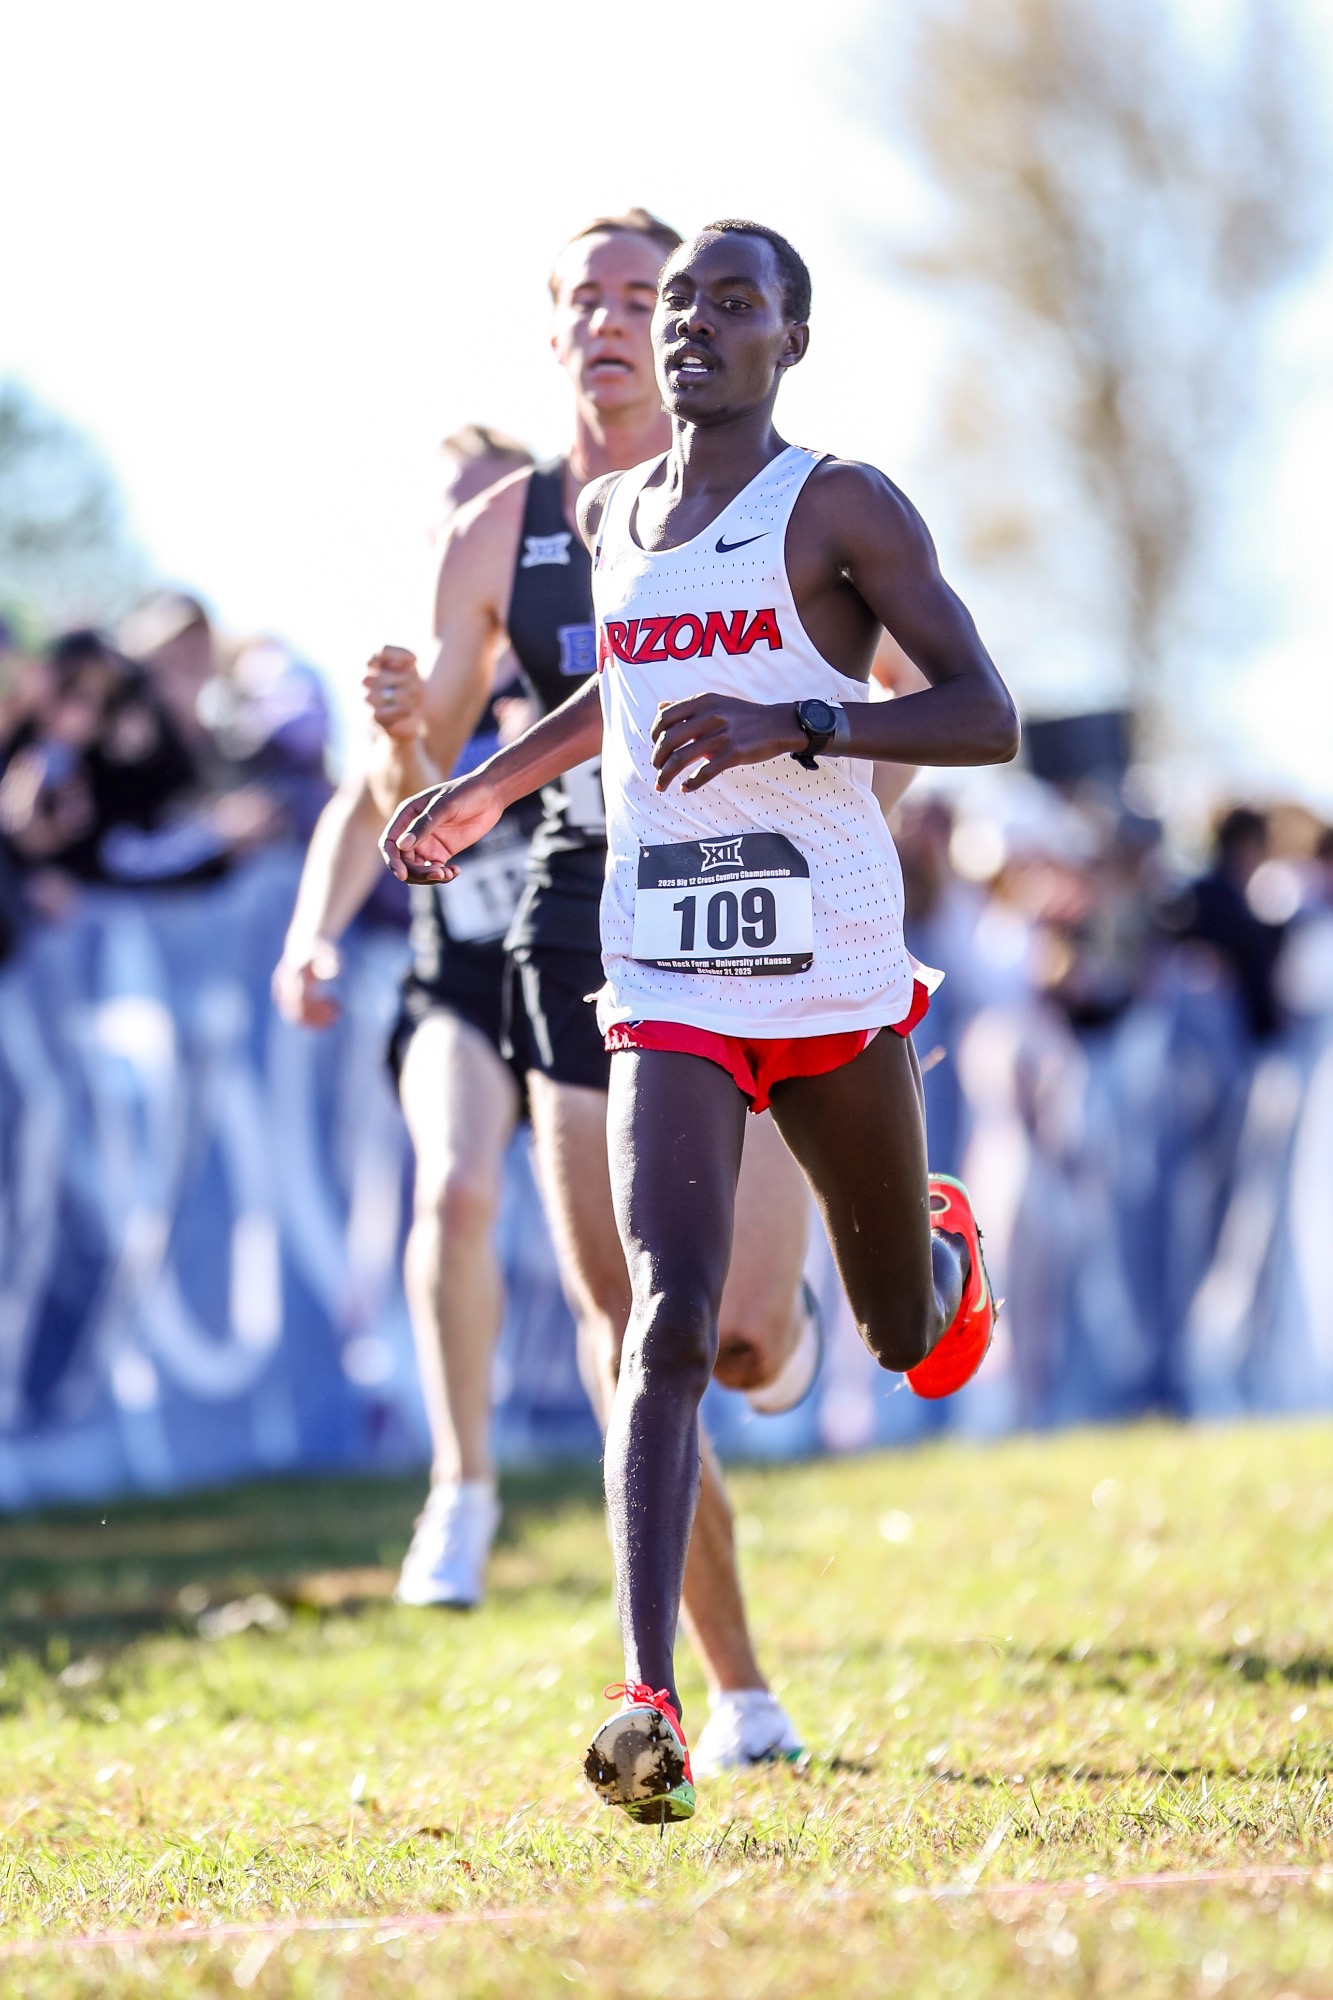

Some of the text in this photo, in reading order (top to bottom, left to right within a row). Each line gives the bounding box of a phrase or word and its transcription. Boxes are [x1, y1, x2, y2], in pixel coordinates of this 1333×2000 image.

[598, 608, 784, 674] ARIZONA
[697, 876, 715, 884] Cross
[716, 873, 739, 882] Country
[740, 868, 790, 878] Championship
[673, 887, 777, 951] 109
[691, 960, 709, 968] Farm
[716, 958, 753, 967] University
[764, 957, 791, 965] Kansas
